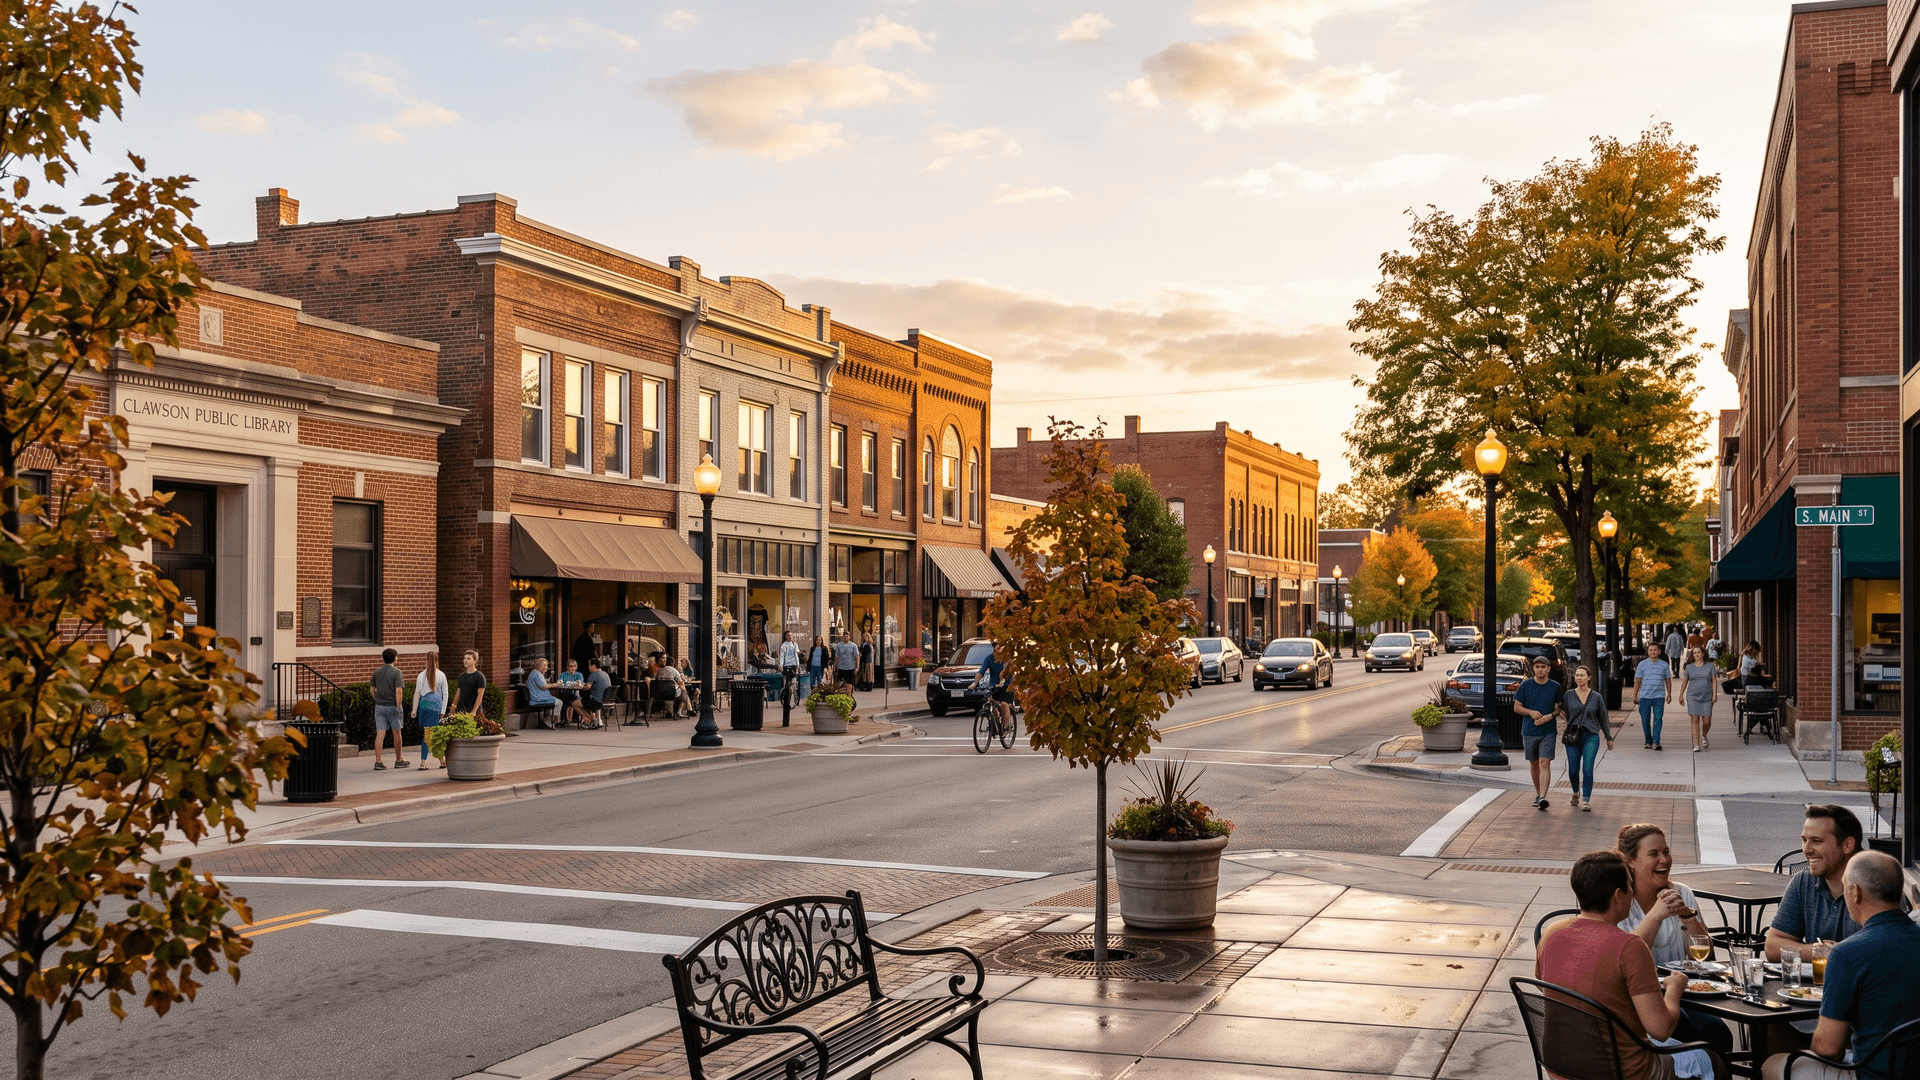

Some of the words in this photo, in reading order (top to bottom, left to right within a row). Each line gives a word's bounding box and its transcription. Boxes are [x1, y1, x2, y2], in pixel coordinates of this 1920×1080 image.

[123, 398, 190, 419] CLAWSON
[195, 408, 239, 427] PUBLIC
[244, 415, 292, 434] LIBRARY
[1802, 510, 1813, 523] S.
[1819, 509, 1850, 523] MAIN
